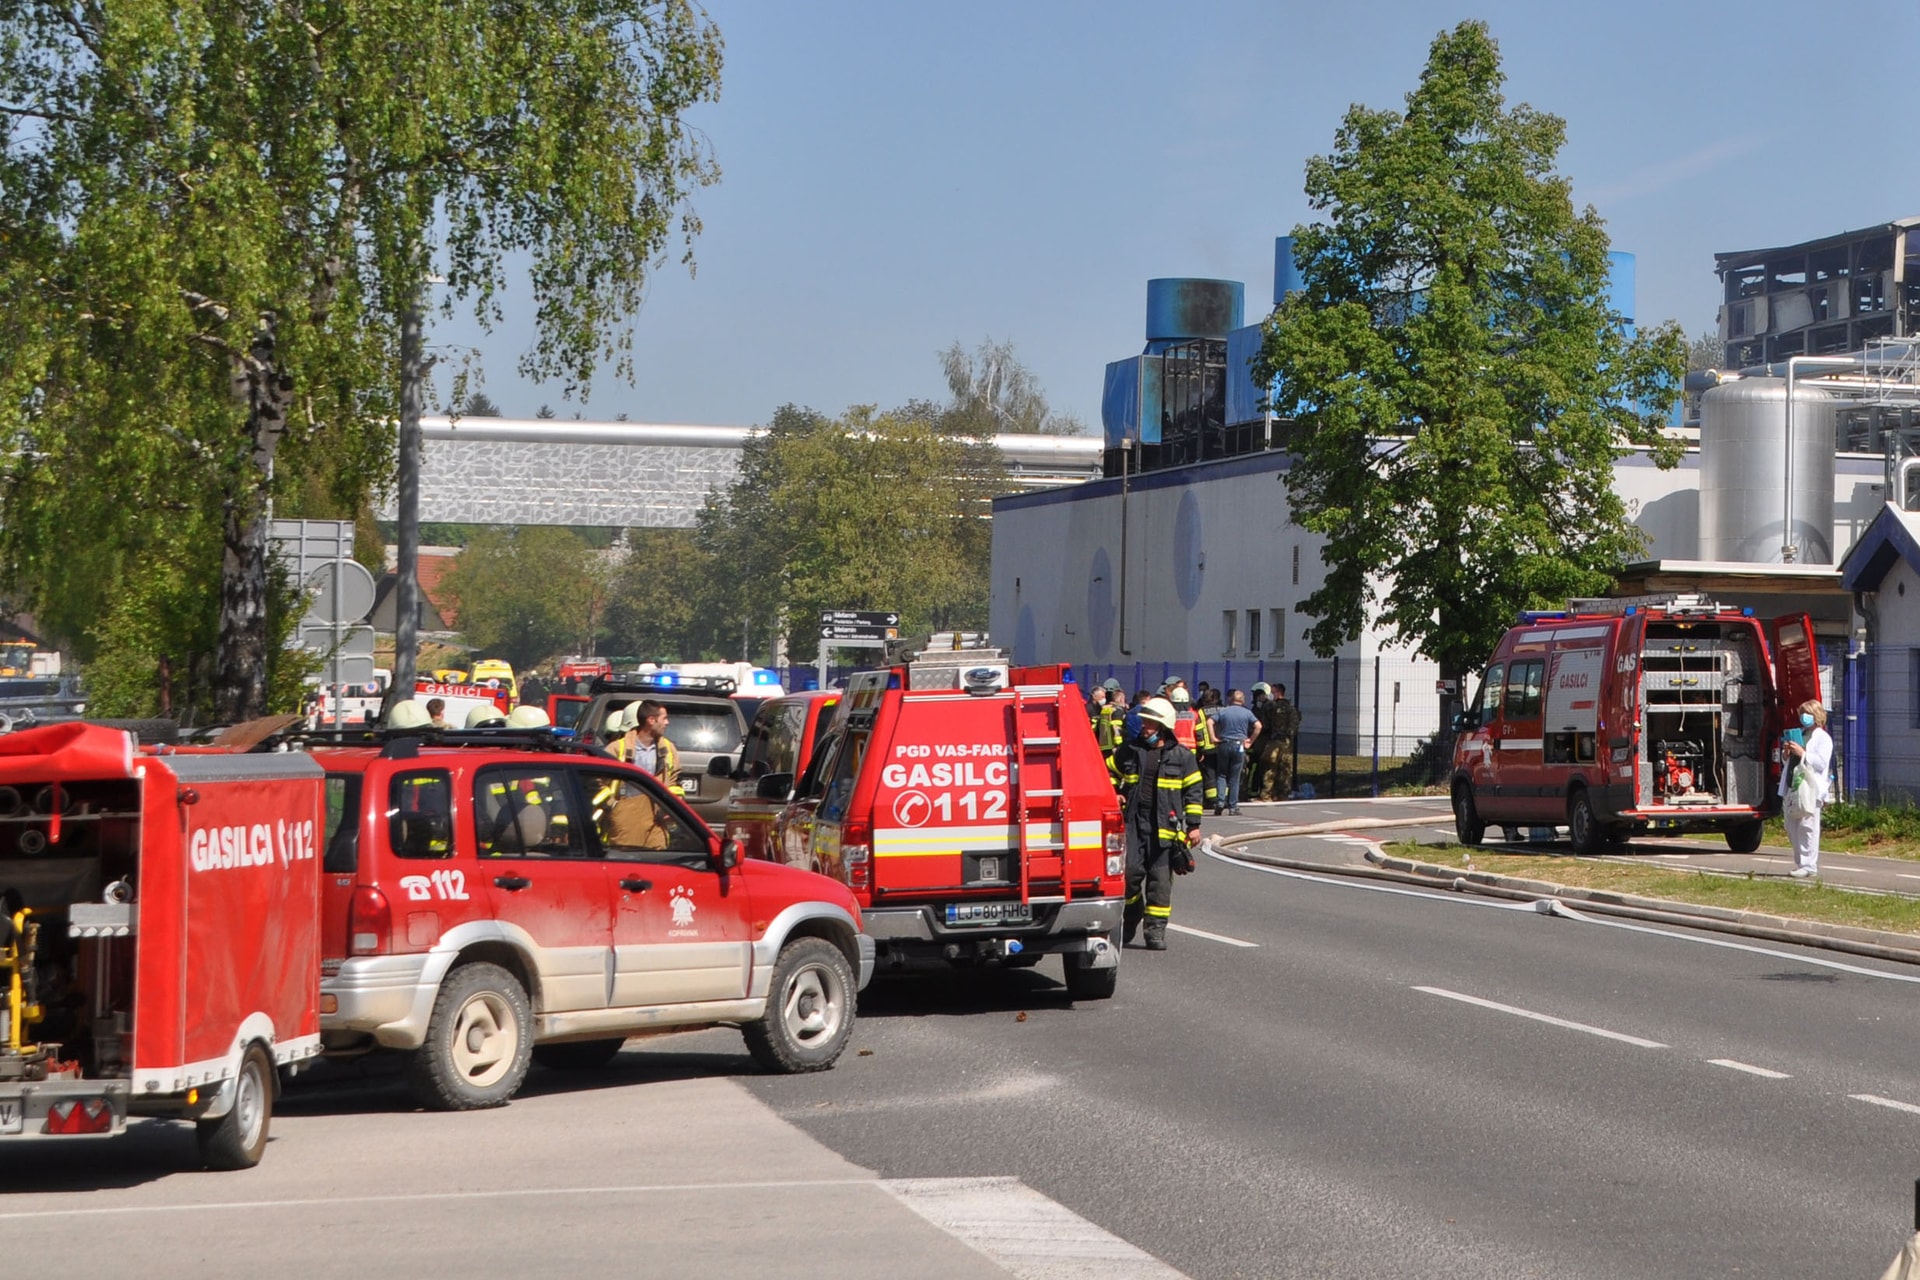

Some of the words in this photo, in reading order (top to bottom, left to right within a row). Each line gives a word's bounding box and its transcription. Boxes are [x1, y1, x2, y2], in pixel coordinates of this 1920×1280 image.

[425, 684, 481, 697] GASILCI
[1560, 672, 1589, 689] GASILCI
[896, 745, 931, 758] PGD
[934, 744, 1014, 757] VAS-FARA
[882, 761, 1018, 788] GASILCI
[933, 790, 1008, 821] 112
[190, 823, 275, 873] GASILCI
[287, 819, 314, 861] 112
[430, 869, 470, 900] 112
